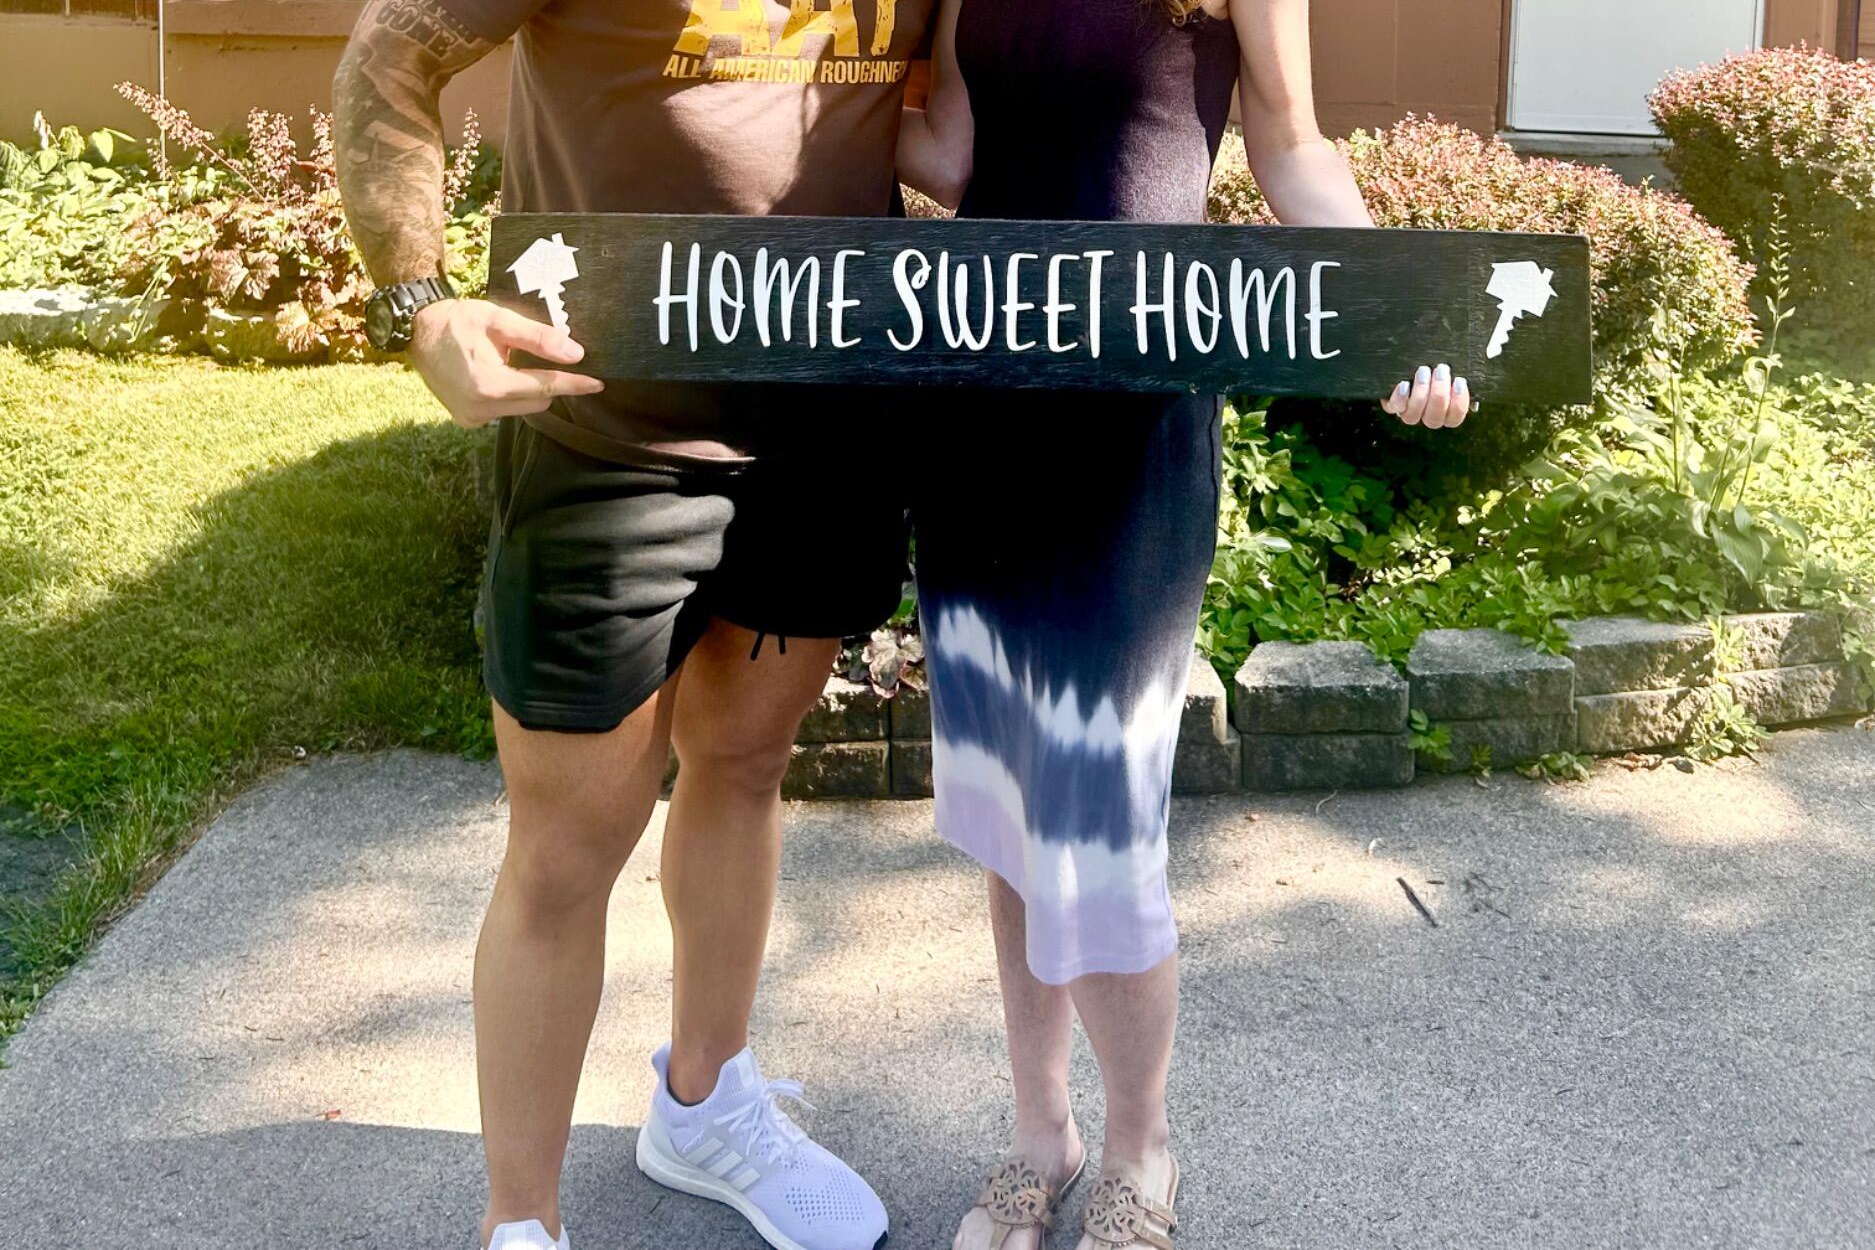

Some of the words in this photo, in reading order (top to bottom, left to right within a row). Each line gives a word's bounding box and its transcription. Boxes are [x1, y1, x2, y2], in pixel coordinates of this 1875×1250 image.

[662, 54, 702, 79] ALL
[709, 57, 816, 84] AMERICAN
[820, 60, 907, 84] ROUGHNE
[652, 241, 866, 352] HOME
[886, 248, 1115, 359] SWEET
[1129, 250, 1341, 362] HOME
